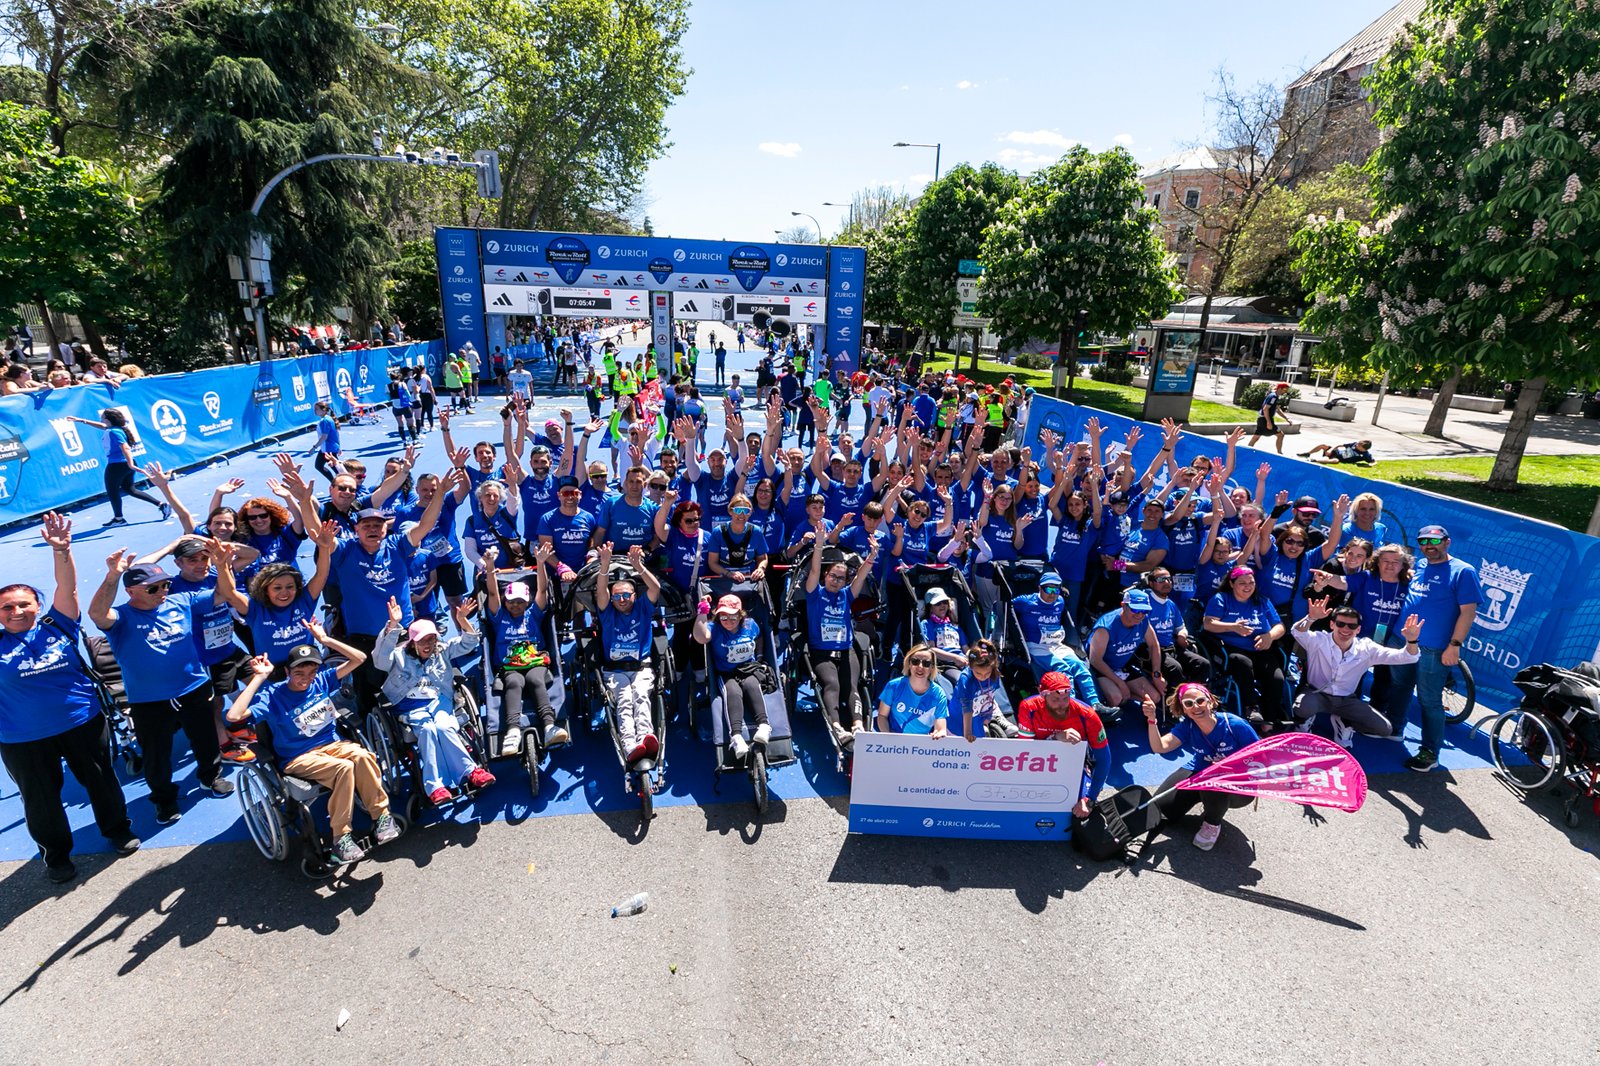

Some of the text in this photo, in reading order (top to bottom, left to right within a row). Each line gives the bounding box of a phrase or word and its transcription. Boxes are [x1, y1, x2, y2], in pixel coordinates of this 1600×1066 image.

[503, 243, 539, 253] ZURICH
[614, 249, 648, 257] ZURICH
[689, 252, 722, 261] ZURICH
[791, 256, 823, 266] ZURICH
[293, 403, 312, 413] MADRID
[198, 423, 214, 433] Rock
[219, 418, 234, 427] Roll
[60, 458, 99, 476] MADRID
[735, 647, 750, 655] SARA
[1460, 636, 1520, 669] DRID
[20, 662, 69, 677] #imparables
[304, 706, 327, 725] ADRIAN
[865, 744, 971, 757] Z Zurich Foundation
[932, 760, 958, 769] dona
[980, 751, 1058, 772] aefat
[1246, 761, 1347, 791] aefat
[909, 786, 945, 795] cantidad
